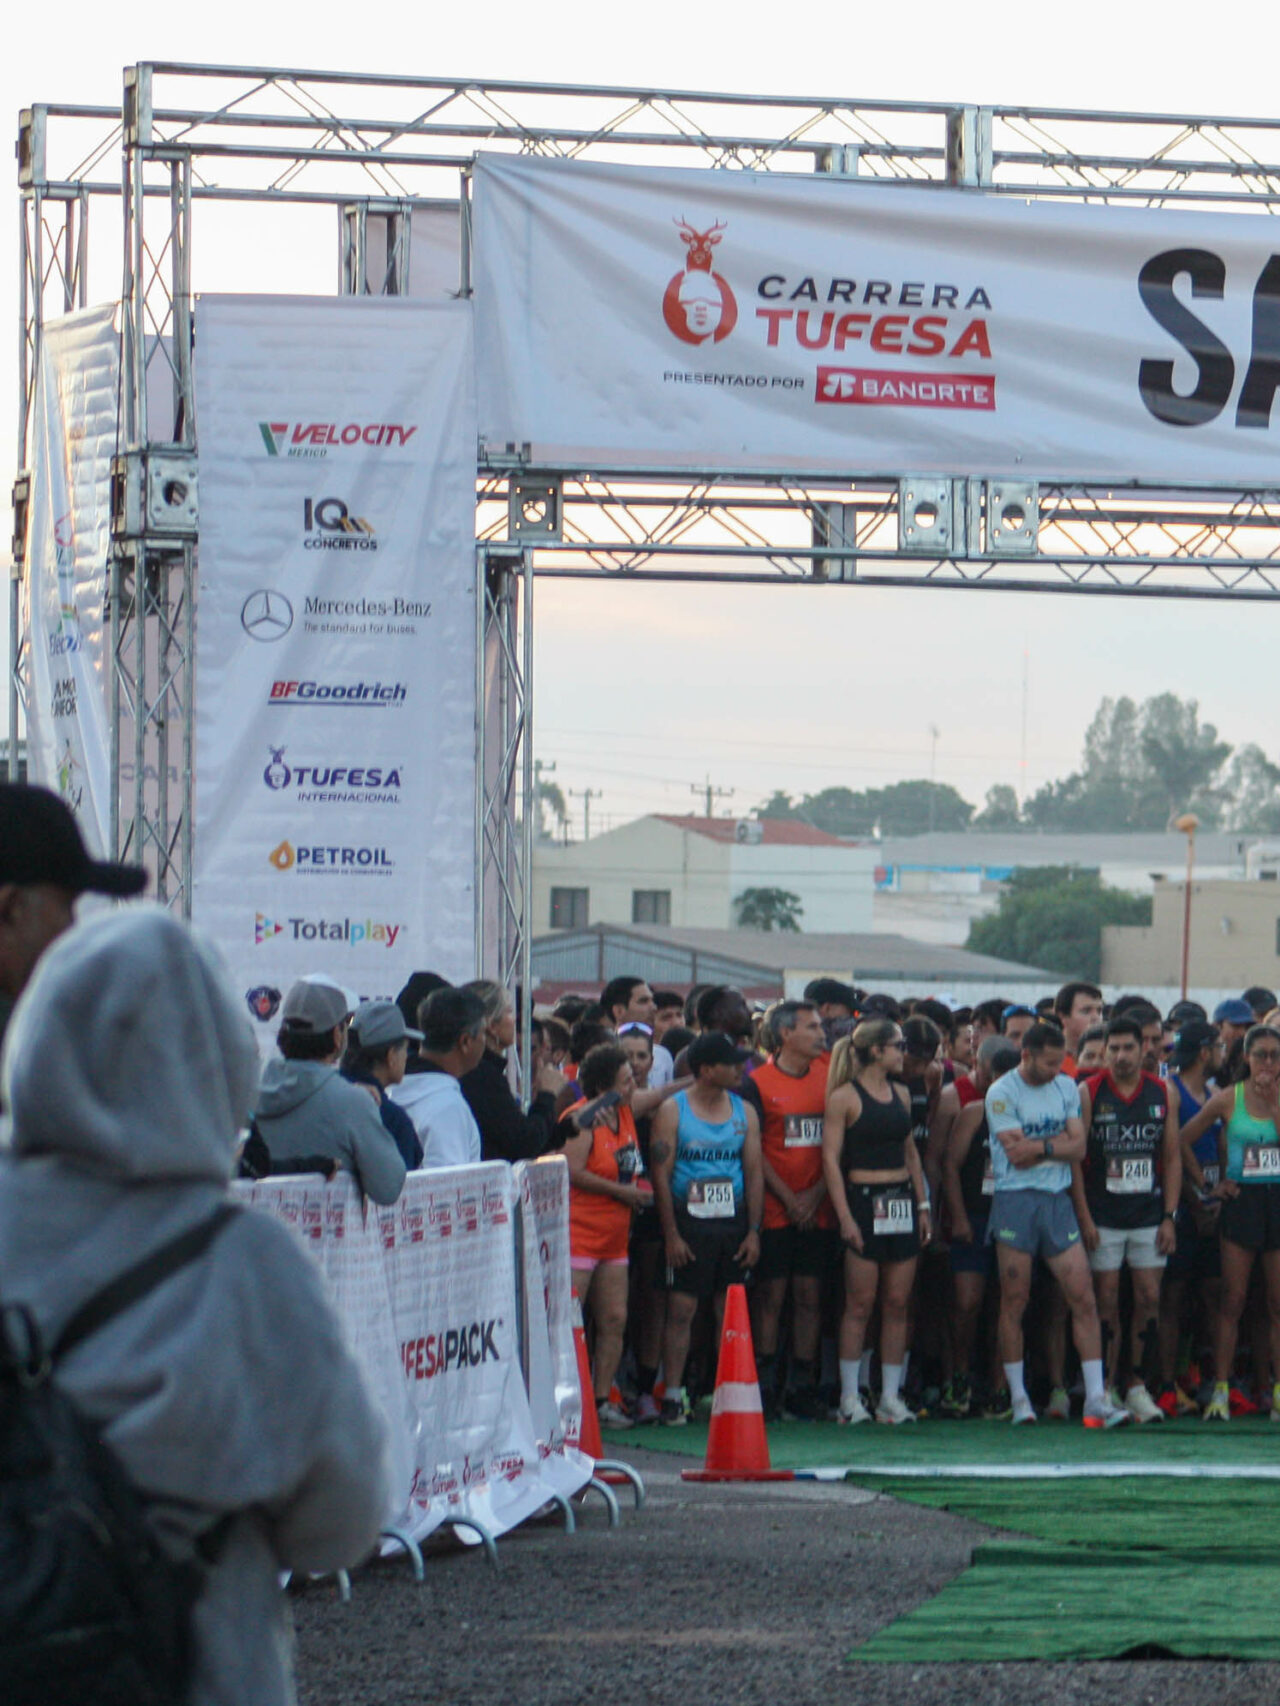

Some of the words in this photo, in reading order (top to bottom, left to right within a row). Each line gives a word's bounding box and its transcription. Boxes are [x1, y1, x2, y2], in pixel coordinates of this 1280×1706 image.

[757, 274, 993, 310] CARRERA
[755, 307, 992, 359] TUFESA
[663, 371, 768, 389] PRESENTADO
[771, 376, 805, 390] POR
[862, 378, 989, 403] BANORTE
[291, 422, 418, 447] VELOCITY
[303, 497, 351, 533] IQ
[303, 537, 378, 551] CONCRETOS
[303, 595, 432, 617] Mercedes-Benz
[320, 622, 367, 634] standard
[369, 622, 384, 634] for
[269, 681, 408, 701] BFGoodrich
[293, 767, 401, 787] TUFESA
[297, 791, 400, 803] INTERNACIONAL
[296, 846, 393, 866] PETROIL
[288, 918, 400, 948] Totalplay
[707, 1186, 731, 1203] 255
[401, 1319, 500, 1380] FESAPACK
